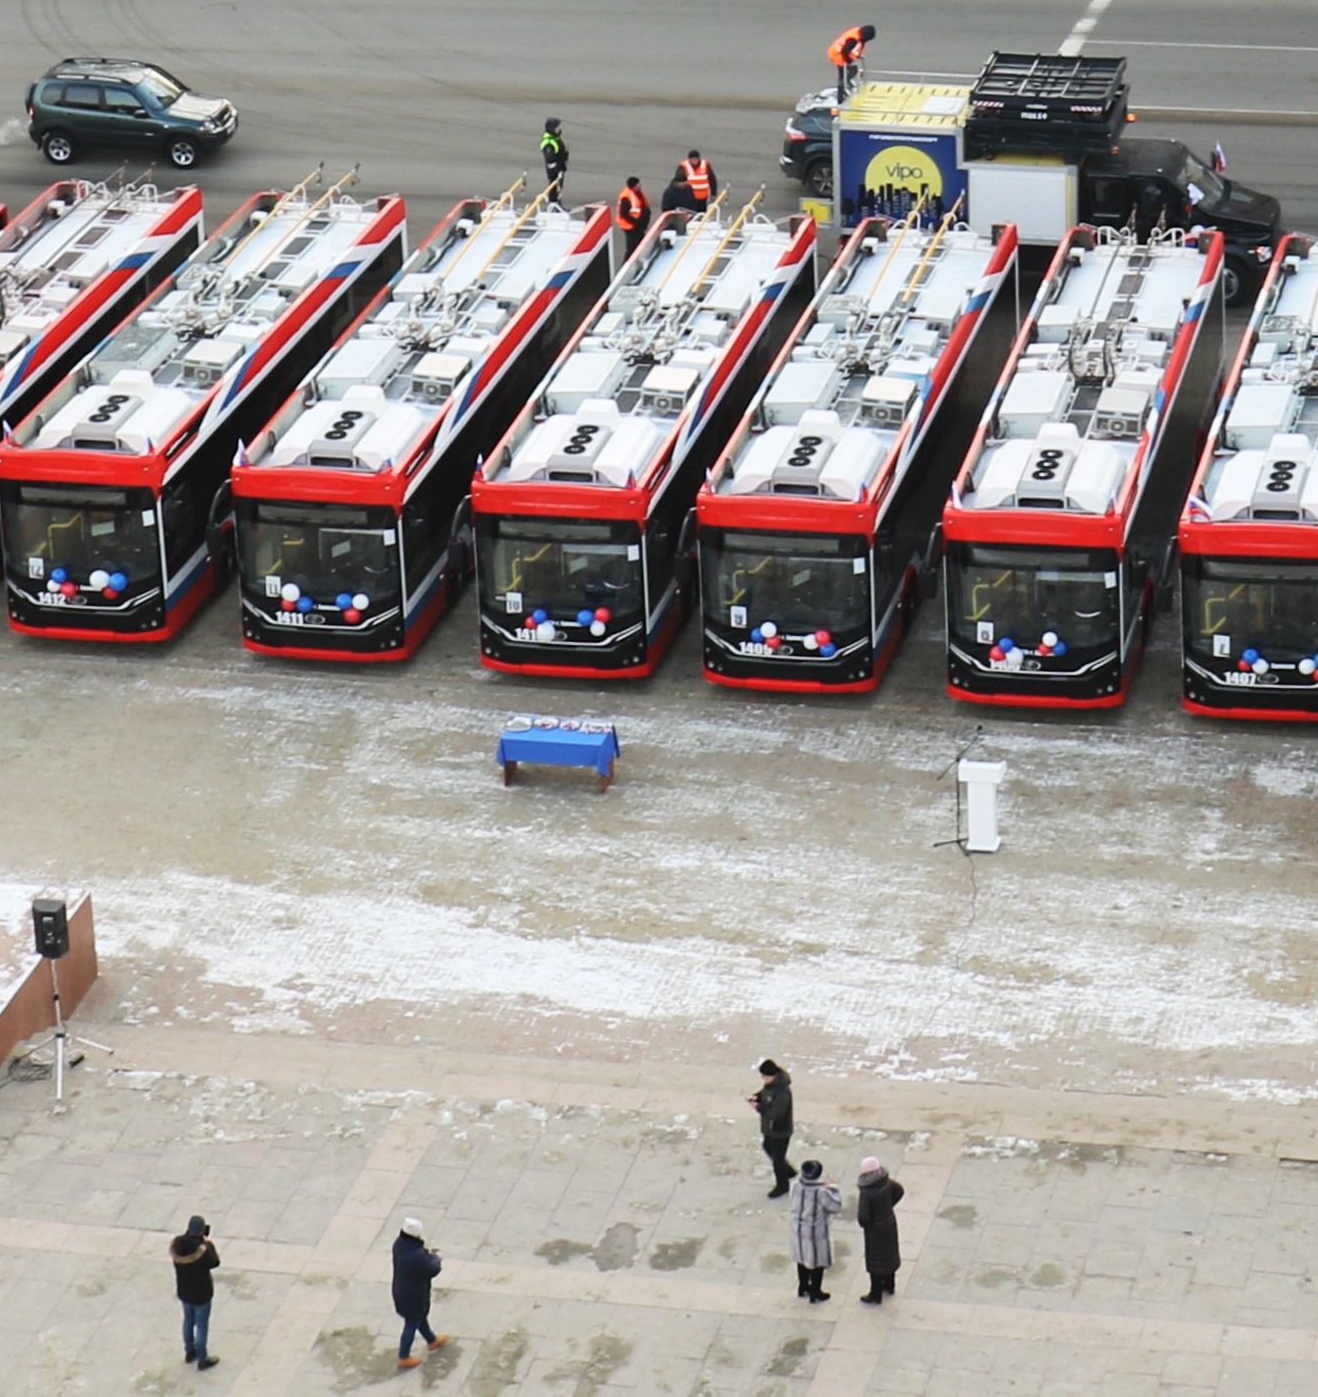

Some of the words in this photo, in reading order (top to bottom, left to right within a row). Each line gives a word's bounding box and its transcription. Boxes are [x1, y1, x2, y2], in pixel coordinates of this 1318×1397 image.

[885, 161, 924, 182] vipo
[37, 591, 67, 605] 1412
[275, 610, 304, 624] 1411
[1223, 671, 1257, 685] 1407
